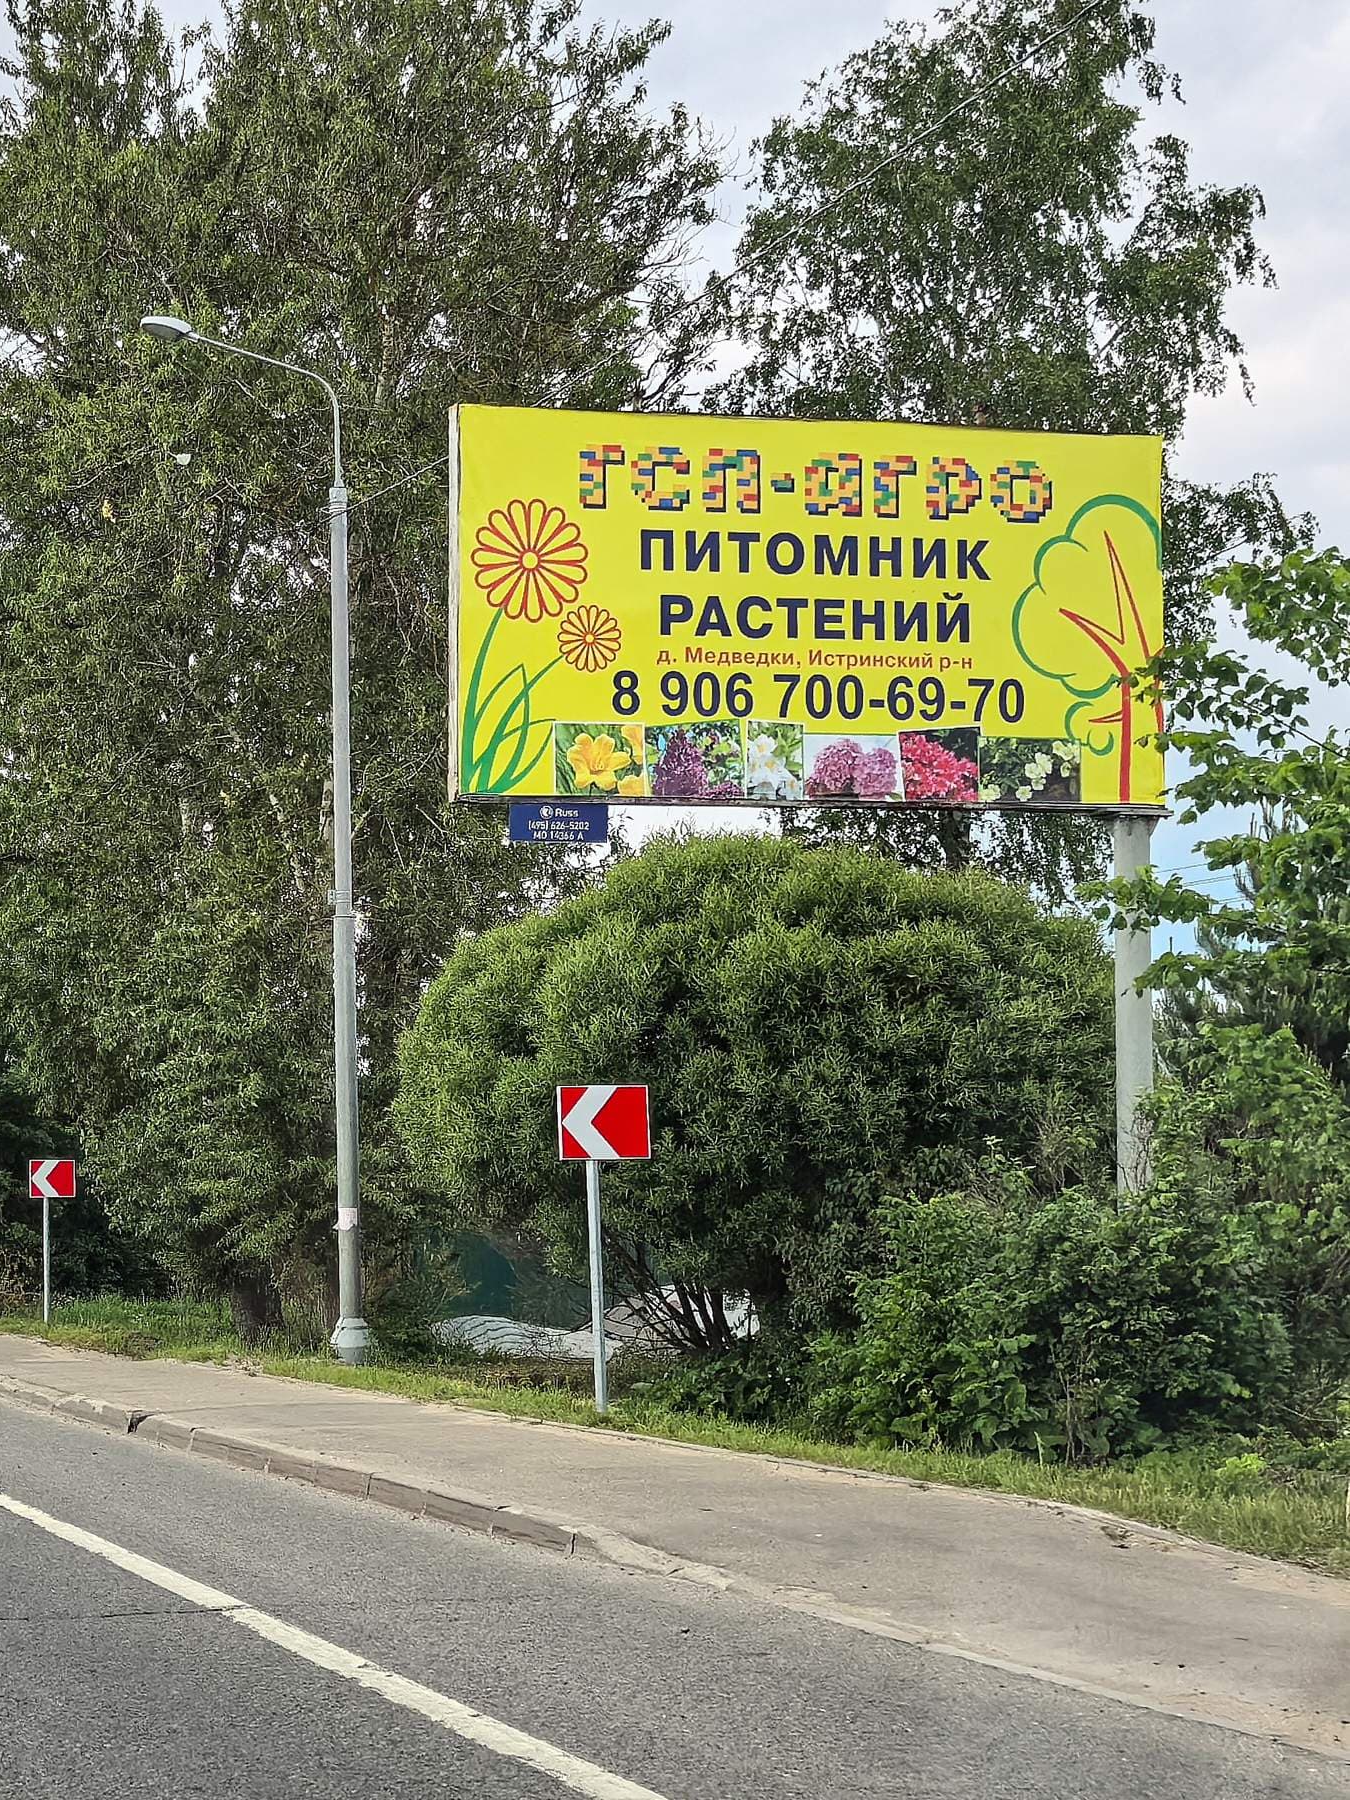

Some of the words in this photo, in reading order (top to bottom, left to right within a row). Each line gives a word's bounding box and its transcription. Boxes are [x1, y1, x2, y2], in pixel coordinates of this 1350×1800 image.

[640, 529, 991, 581] ПИТОМНИК
[659, 592, 971, 643] РАСТЕНИЙ
[656, 650, 678, 667] д.
[685, 648, 801, 668] Медведки,
[808, 650, 933, 670] Истринский
[939, 655, 973, 671] р-н
[612, 670, 641, 716] 8
[660, 671, 754, 718] 906
[772, 673, 1025, 723] 700-69-70
[528, 820, 549, 831] (495)
[555, 808, 579, 818] Russ
